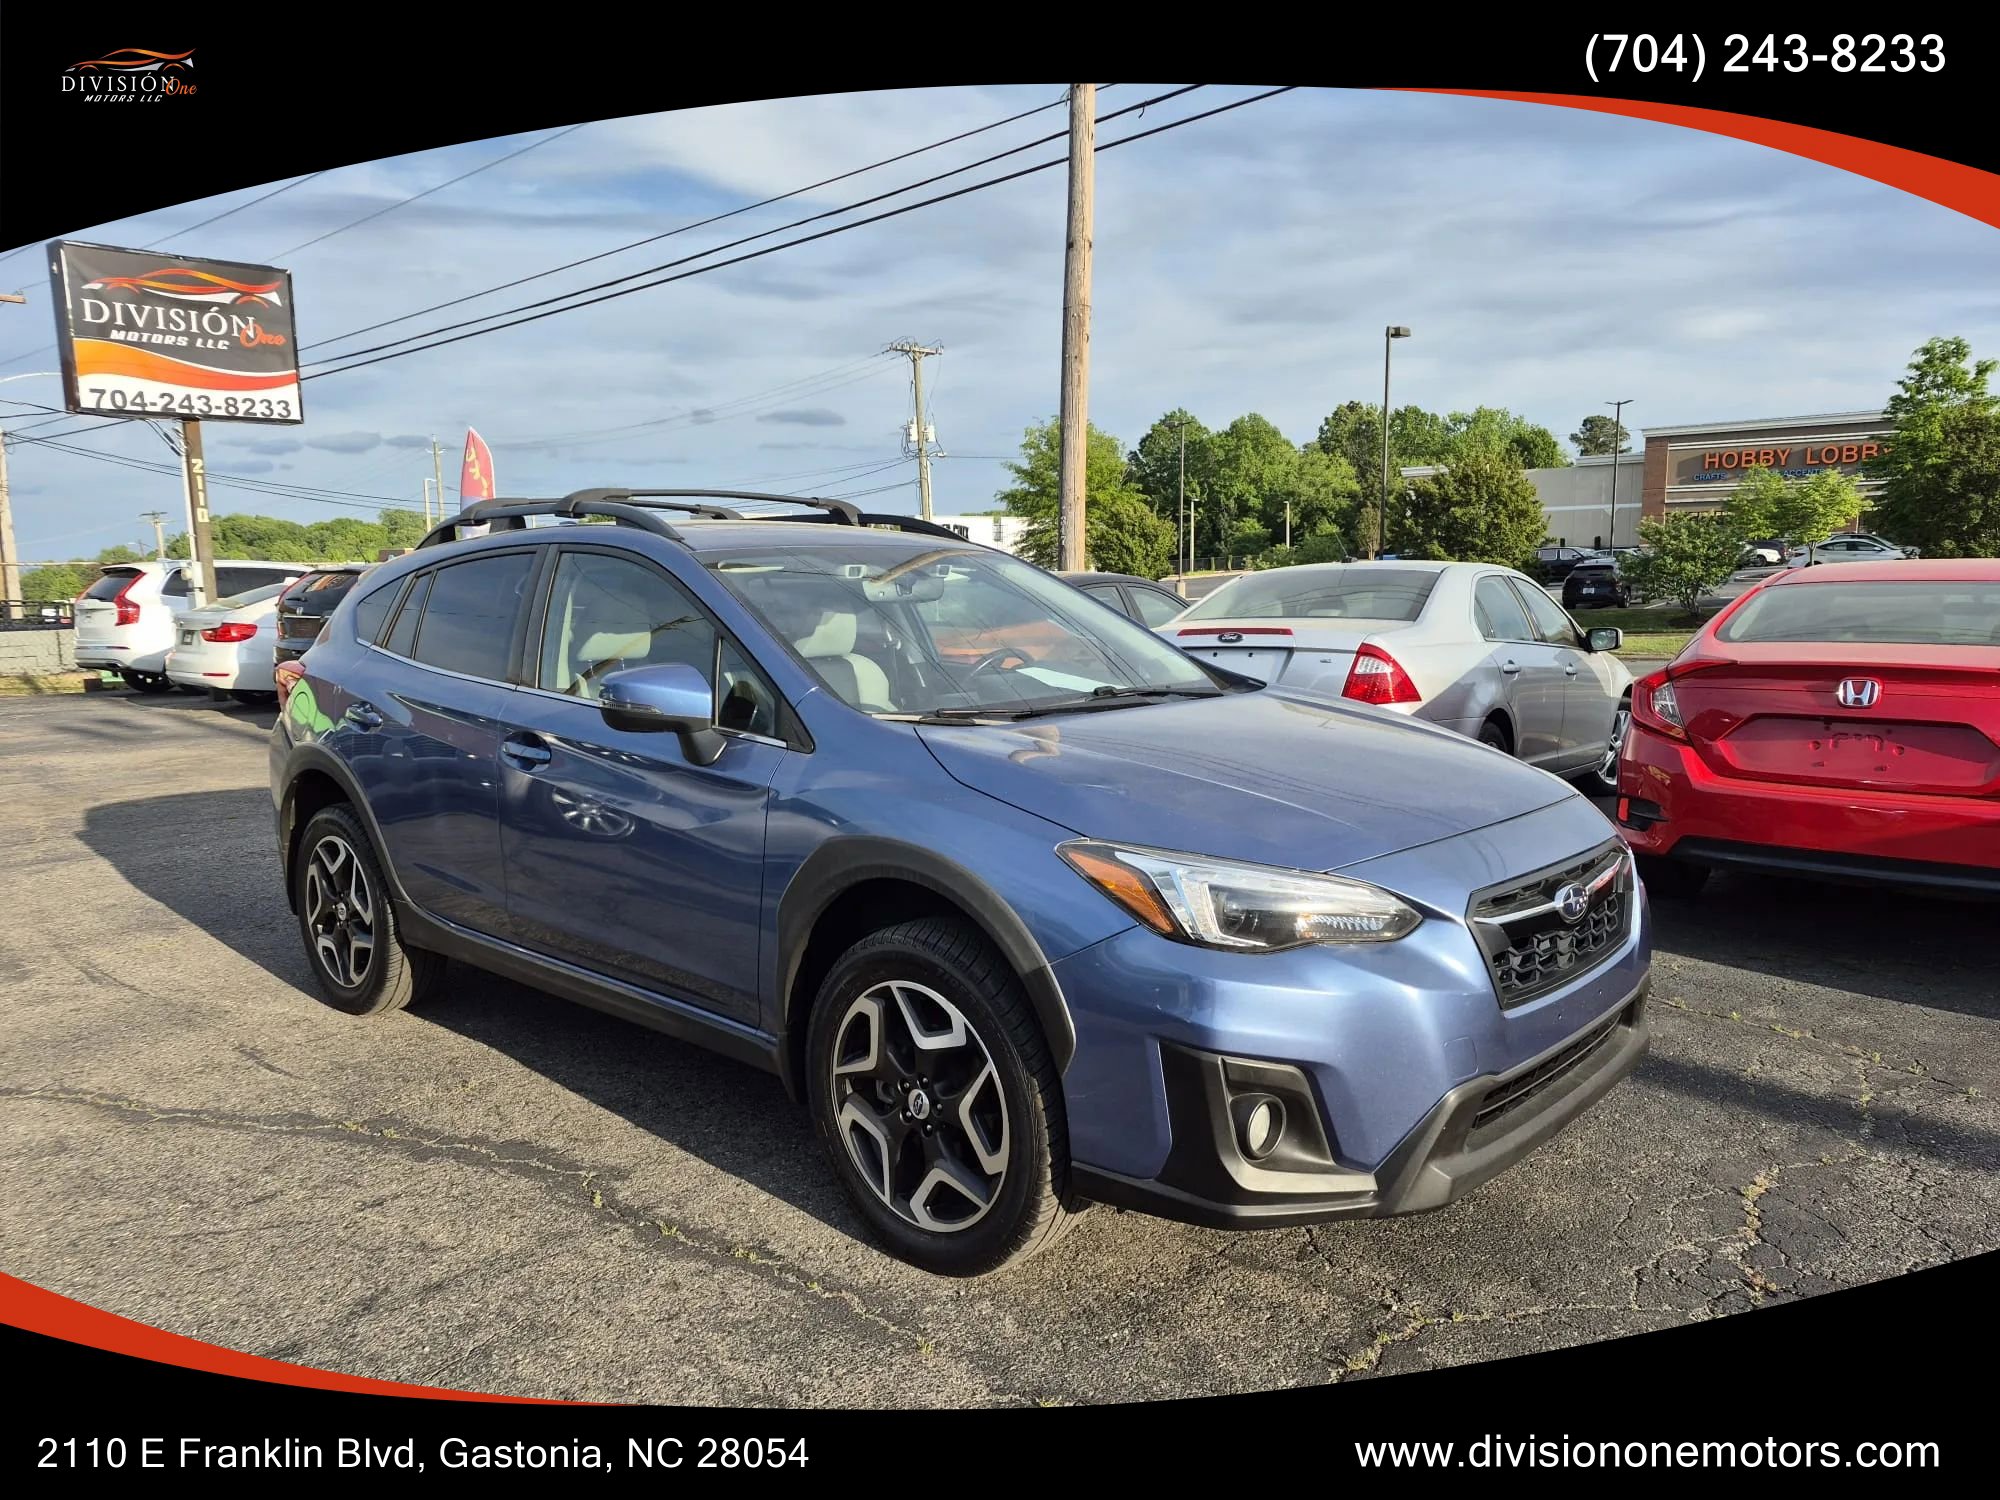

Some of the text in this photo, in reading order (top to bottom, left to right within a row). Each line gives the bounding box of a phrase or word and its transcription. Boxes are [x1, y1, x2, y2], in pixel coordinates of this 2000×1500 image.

[80, 298, 287, 347] DIVISIÓN One
[110, 329, 231, 350] MOTORS LLC
[88, 387, 292, 418] 704-243-8233
[1703, 448, 1792, 469] HOBBY
[1693, 472, 1728, 481] CRAFTS
[192, 458, 210, 523] 2110
